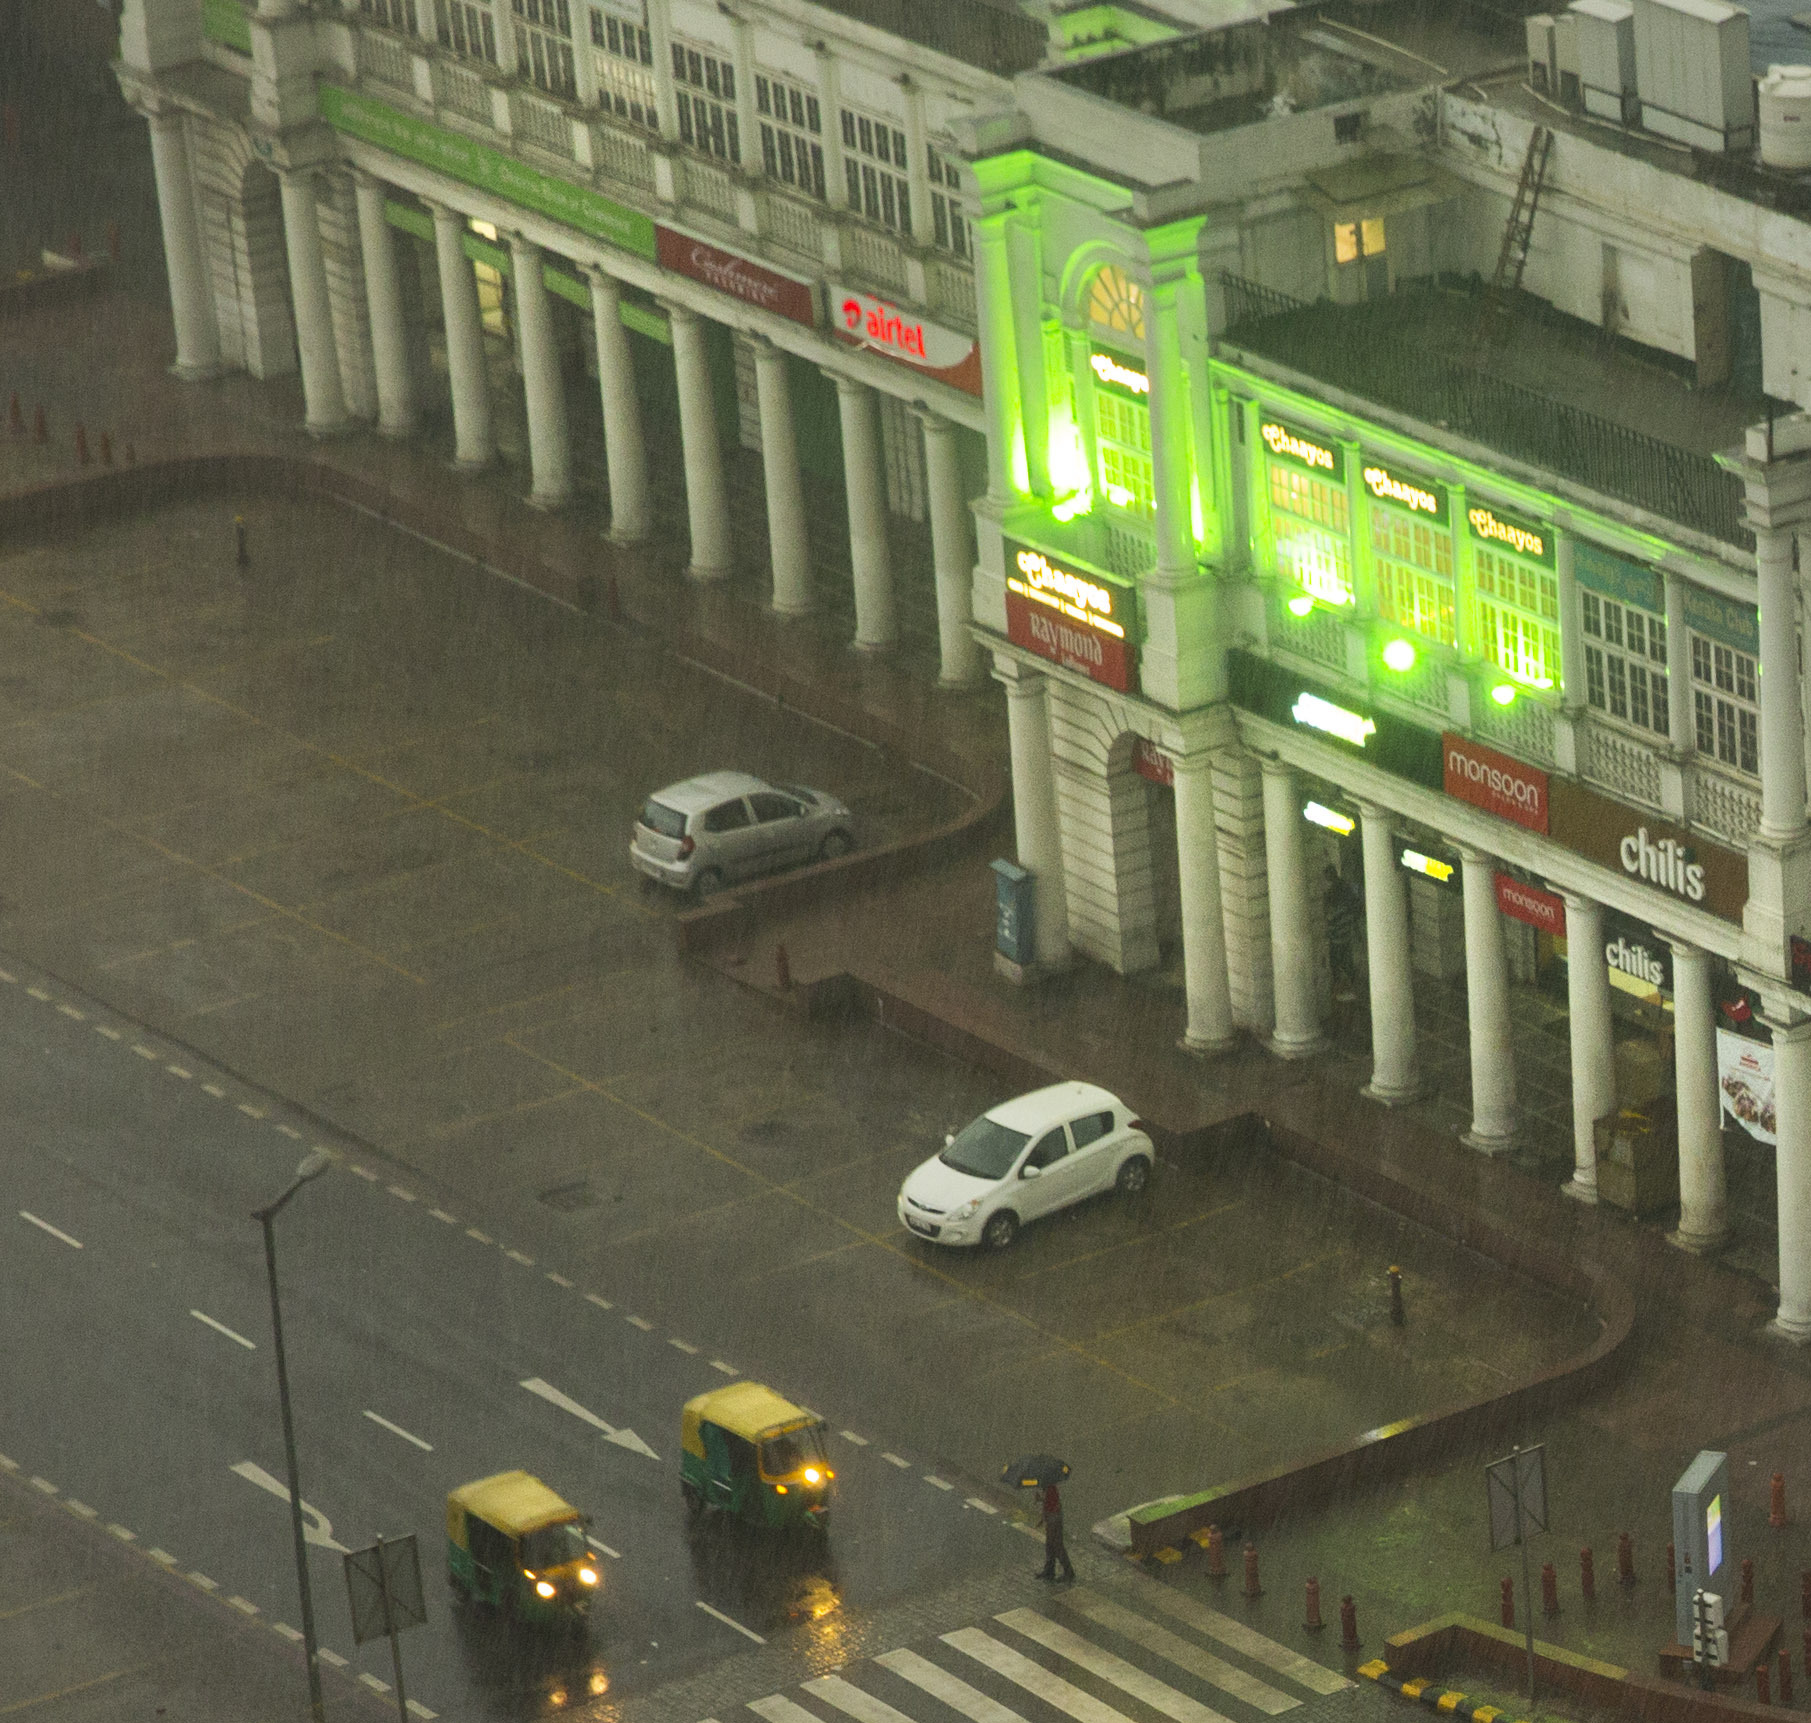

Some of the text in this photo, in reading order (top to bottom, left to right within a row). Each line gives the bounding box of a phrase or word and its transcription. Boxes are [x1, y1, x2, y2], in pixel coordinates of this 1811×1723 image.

[866, 306, 927, 359] airtel
[1469, 508, 1543, 556] Chaayos
[1030, 612, 1103, 667] Raymond
[1450, 751, 1539, 805] monsoon
